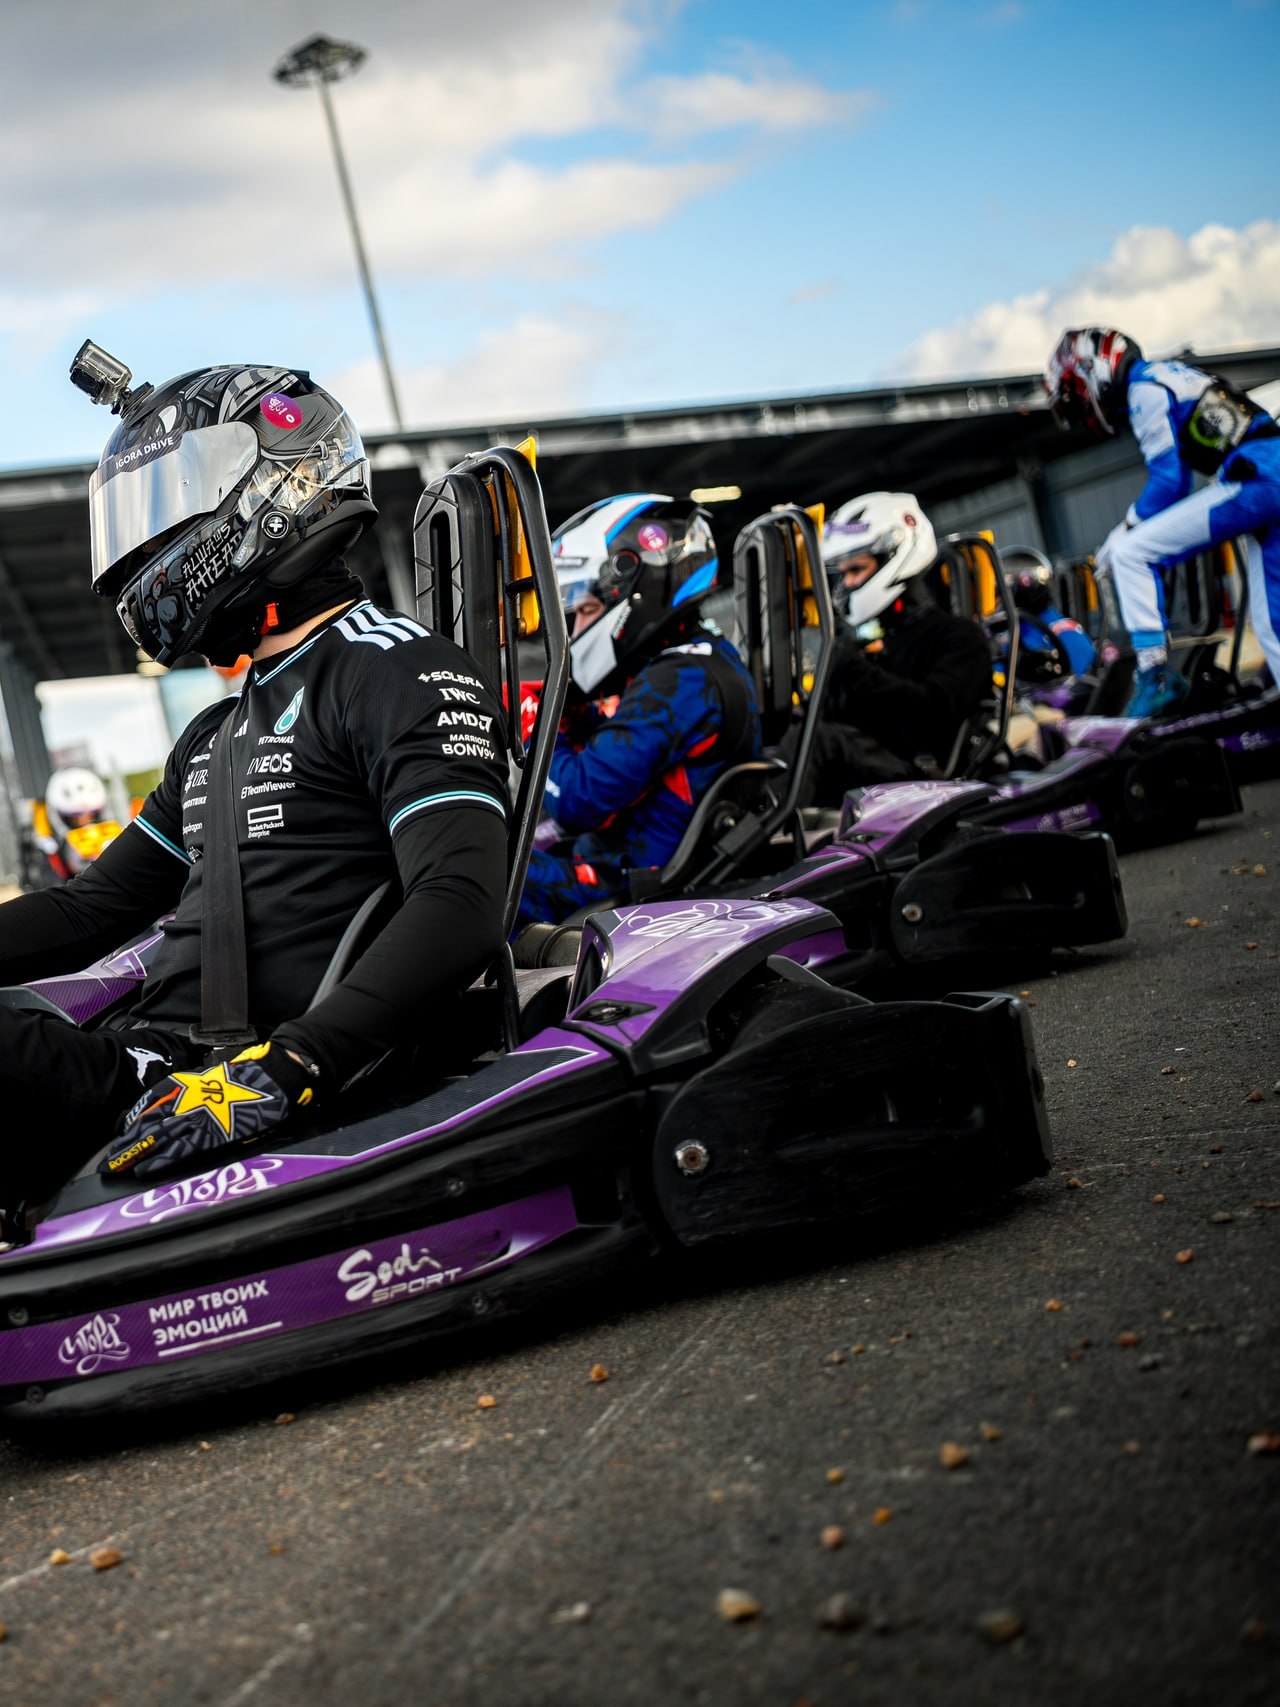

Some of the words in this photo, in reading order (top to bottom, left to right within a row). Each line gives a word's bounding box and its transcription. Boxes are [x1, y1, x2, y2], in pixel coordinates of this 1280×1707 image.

[115, 449, 143, 470] IGORA
[143, 436, 174, 454] DRIVE
[182, 522, 231, 579] ALWAYS
[430, 670, 485, 690] SOLERA
[438, 687, 481, 705] IWC
[437, 711, 479, 727] AMD
[257, 735, 295, 746] PETRONAS
[449, 733, 491, 748] MARRIOTT
[441, 743, 495, 760] BONVOY
[246, 752, 293, 775] INEOS
[247, 781, 296, 797] TeamViewer
[337, 1243, 442, 1302] Sodi
[371, 1267, 463, 1303] SPORT
[148, 1298, 196, 1324] МИР
[197, 1279, 269, 1311] ТВОИХ
[152, 1304, 249, 1346] ЭМОЦИЙ
